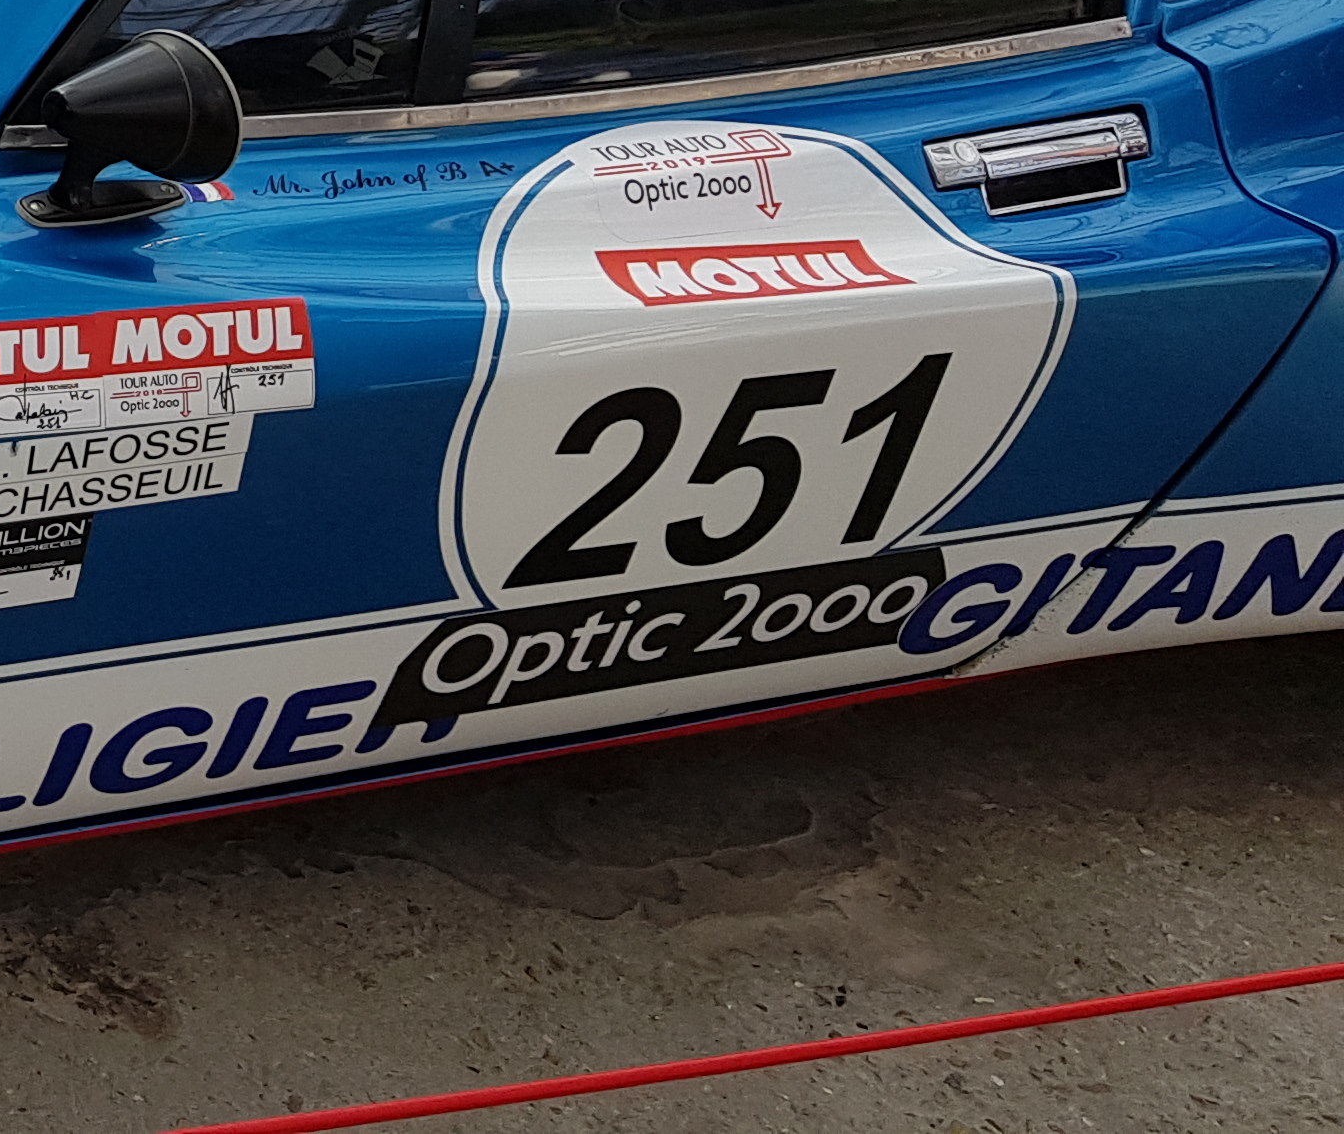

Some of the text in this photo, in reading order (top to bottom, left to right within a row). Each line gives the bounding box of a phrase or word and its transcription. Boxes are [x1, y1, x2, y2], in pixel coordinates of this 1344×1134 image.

[590, 134, 727, 162] TOUR AUTO
[645, 156, 708, 171] 2019
[252, 174, 311, 196] Mr.
[321, 168, 396, 200] John
[403, 164, 429, 191] of
[624, 172, 752, 212] Optic 2000
[625, 251, 885, 299] MOTUL
[111, 306, 304, 365] MOTUL
[120, 374, 178, 389] TOUR AUTO
[120, 398, 180, 412] Optic 2000
[26, 420, 231, 475] LAFOSSE
[501, 351, 954, 592] 251
[898, 528, 1344, 656] GITAN
[421, 574, 932, 706] Optic 2000
